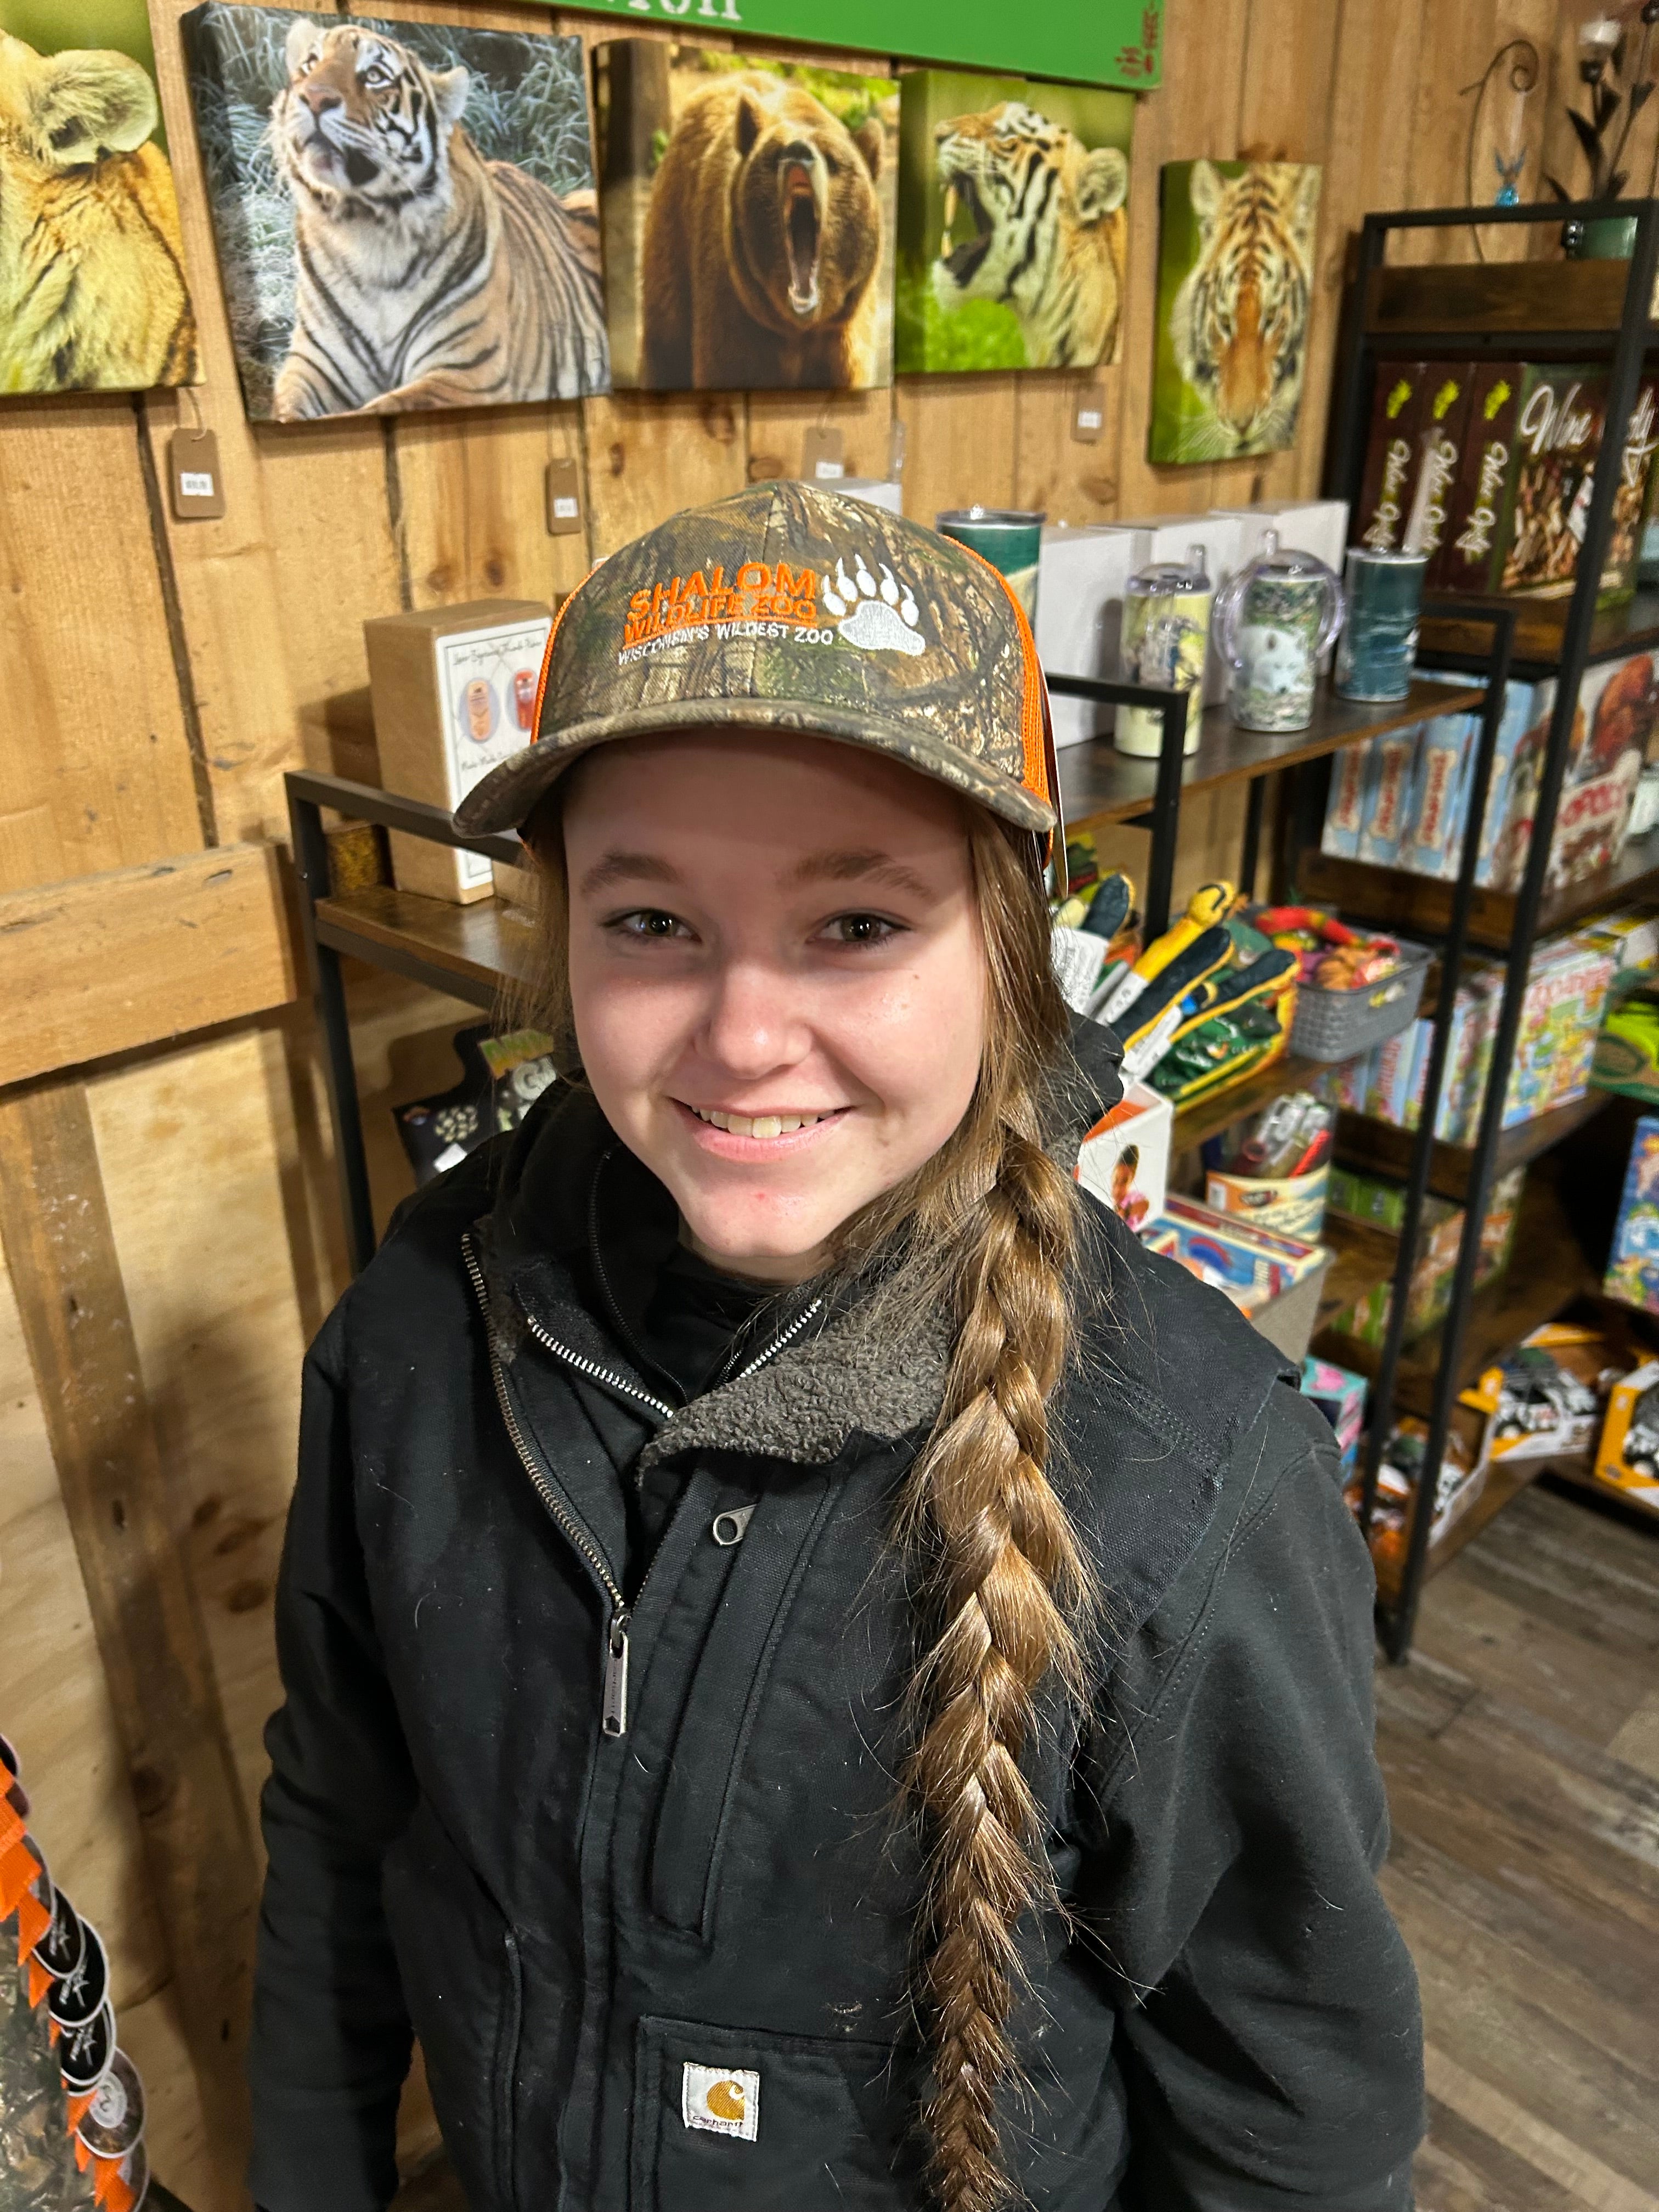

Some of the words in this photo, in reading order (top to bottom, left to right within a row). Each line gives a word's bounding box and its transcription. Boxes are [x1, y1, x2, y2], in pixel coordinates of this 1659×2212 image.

[627, 562, 816, 621] SHALOM
[624, 594, 745, 643] WILDLIFE
[750, 595, 817, 620] ZOO
[618, 624, 709, 665] WISCONSIN'S
[716, 622, 789, 640] WILDEST
[794, 627, 834, 645] ZOO
[692, 2115, 743, 2128] carhartt
